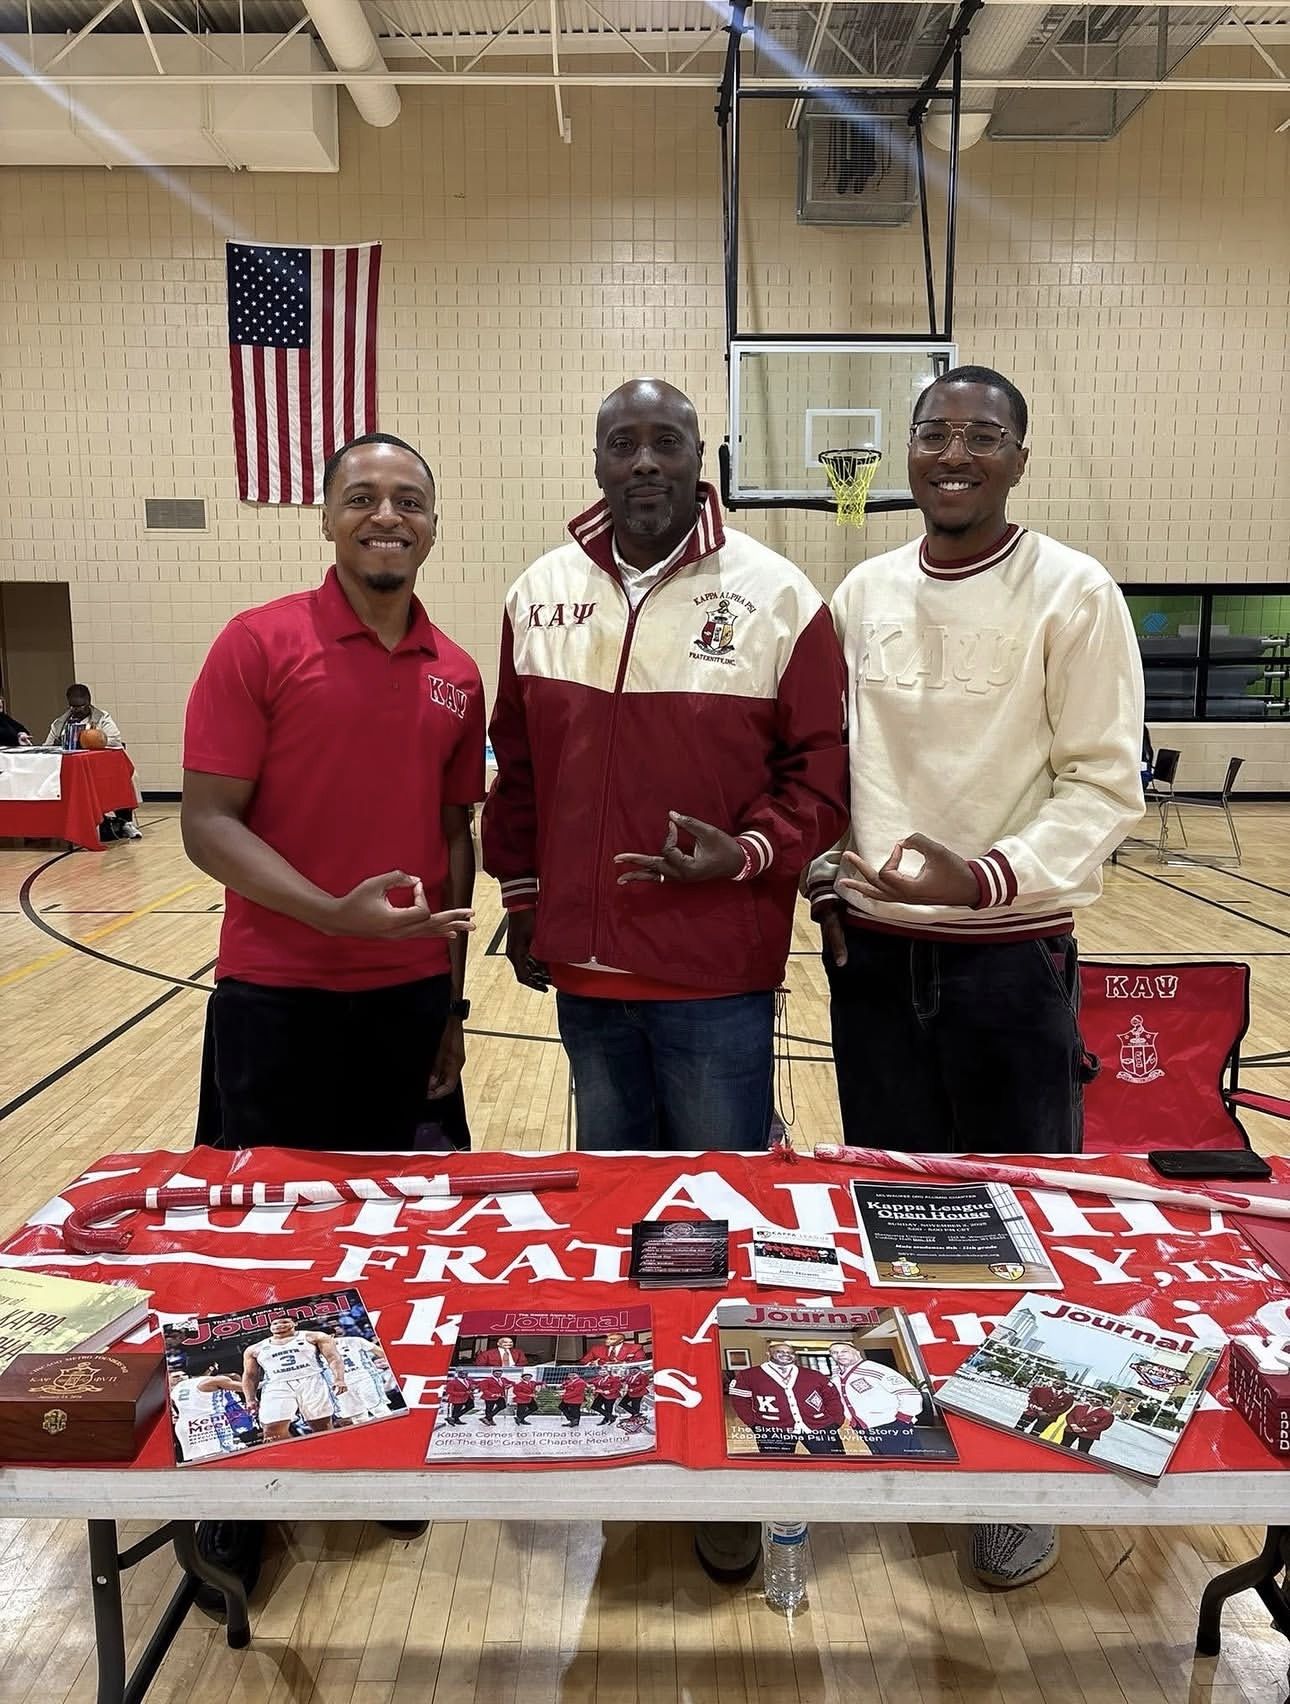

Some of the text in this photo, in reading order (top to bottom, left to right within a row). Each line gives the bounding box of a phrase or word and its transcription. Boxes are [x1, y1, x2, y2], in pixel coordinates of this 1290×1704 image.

[693, 592, 757, 614] KAPPA ALPHA PSI
[867, 1201, 994, 1212] Kappa League
[878, 1209, 990, 1220] Open House
[181, 1295, 351, 1346] Journal
[490, 1311, 629, 1331] Journal
[745, 1307, 880, 1325] Journal
[1040, 1304, 1195, 1354] Journal
[279, 1355, 297, 1367] 3
[756, 1395, 780, 1413] K
[437, 1431, 473, 1439] Kappa
[475, 1431, 513, 1439] Comes
[531, 1430, 567, 1439] Tampa
[584, 1430, 608, 1438] Kick
[730, 1426, 752, 1434] The
[754, 1426, 784, 1434] Sixth
[869, 1428, 901, 1438] Story
[902, 1428, 914, 1436] of
[731, 1432, 769, 1442] Kappa
[771, 1433, 805, 1442] Alpha
[808, 1434, 825, 1442] Psi
[827, 1434, 837, 1442] is
[840, 1434, 884, 1442] Written
[539, 1438, 583, 1448] Chapter
[586, 1434, 631, 1444] Meeting
